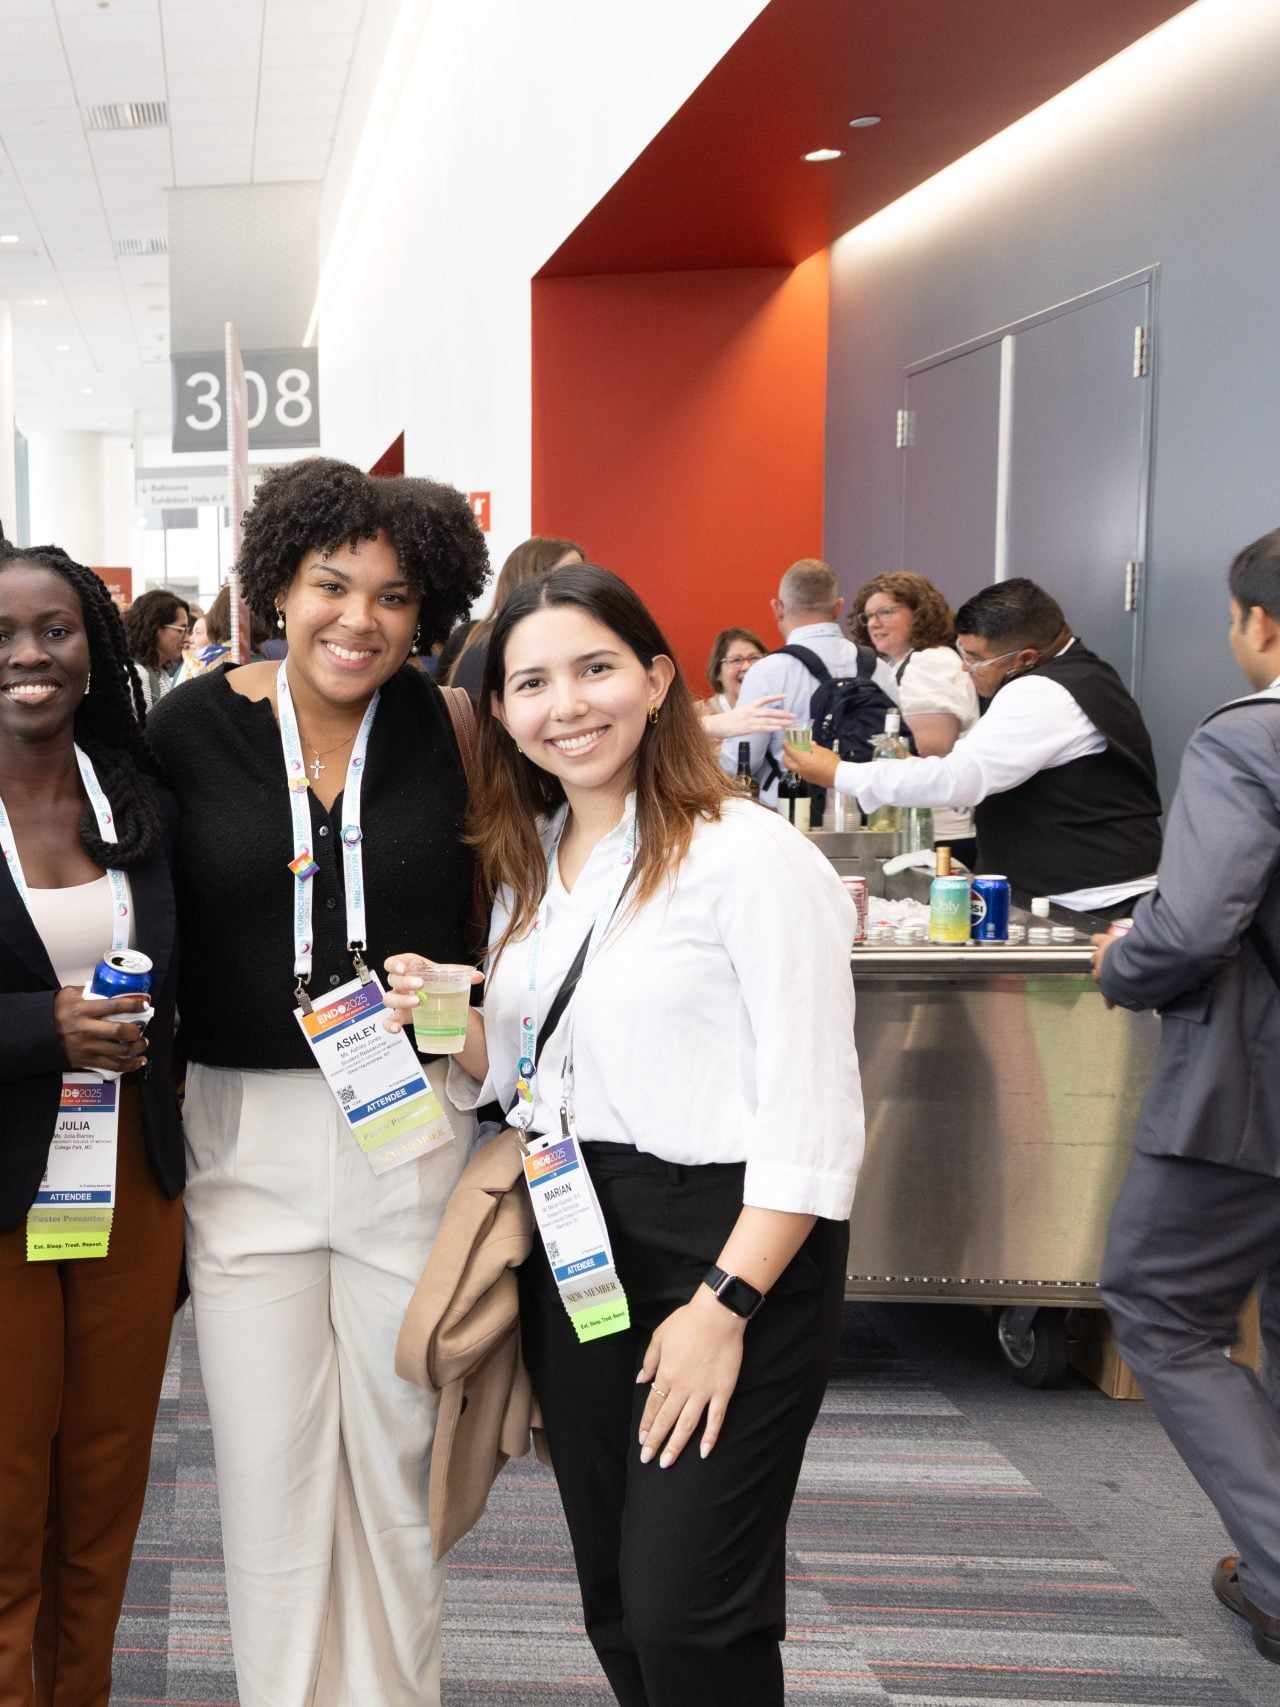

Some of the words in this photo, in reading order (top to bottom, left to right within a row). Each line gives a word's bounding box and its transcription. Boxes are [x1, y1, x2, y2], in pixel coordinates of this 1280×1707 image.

[351, 853, 362, 912] NEUROCRINE
[297, 880, 305, 938] NEUROCRINE
[336, 1023, 377, 1051] ASHLEY
[367, 1087, 407, 1113] ATTENDEE
[59, 1121, 91, 1131] JULIA
[50, 1193, 92, 1201] ATTENDEE
[544, 1183, 572, 1202] MARIAN
[567, 1258, 596, 1275] ATTENDEE
[566, 1291, 583, 1304] NEW
[583, 1282, 617, 1298] MEMBER
